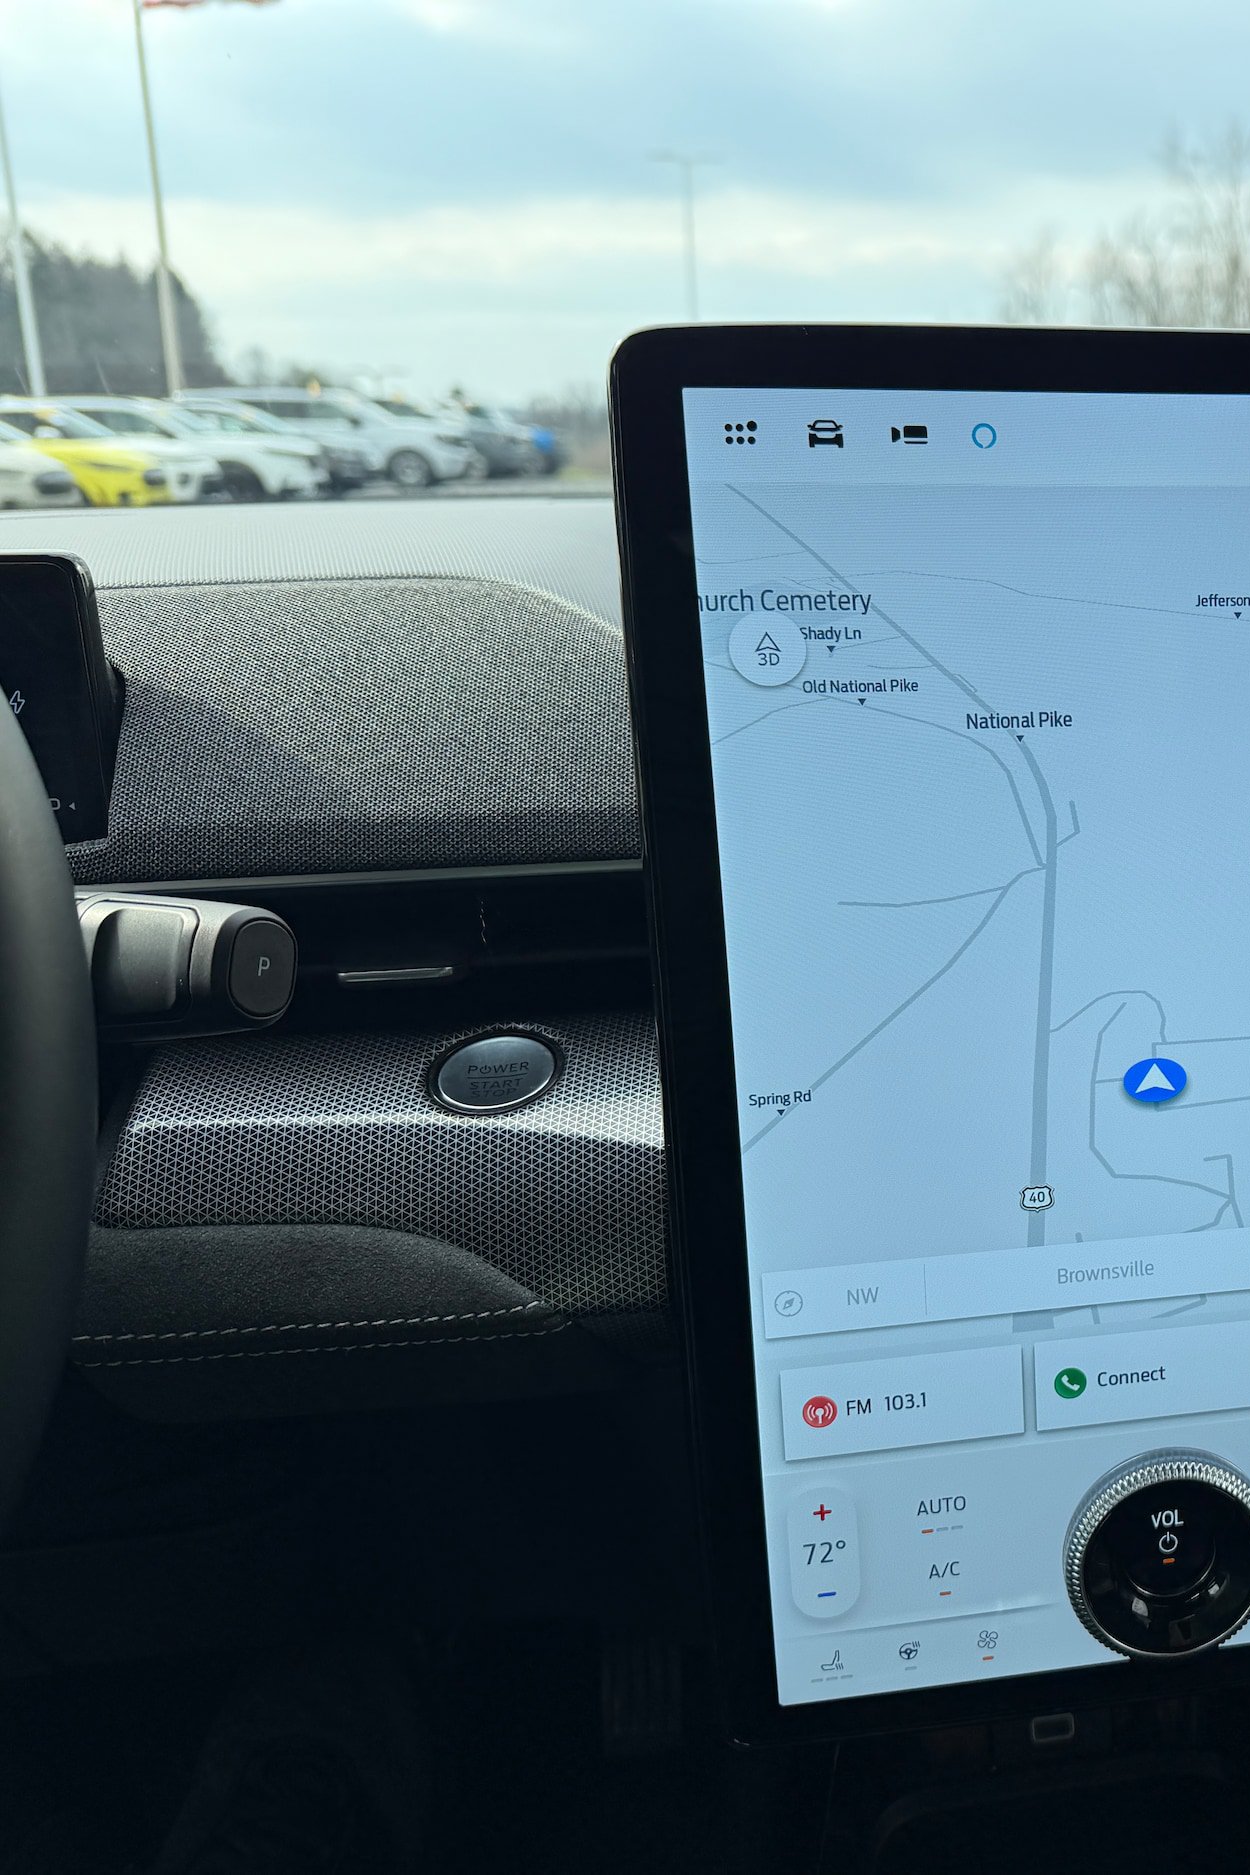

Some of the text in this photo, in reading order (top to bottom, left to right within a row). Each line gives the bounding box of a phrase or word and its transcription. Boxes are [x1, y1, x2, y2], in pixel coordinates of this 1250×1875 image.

[760, 589, 872, 615] Cemetery
[1195, 593, 1250, 607] Jefferson
[800, 626, 862, 643] Shady Ln
[757, 652, 781, 666] 3D
[802, 678, 919, 694] Old National Pike
[966, 710, 1073, 730] National Pike
[257, 956, 271, 977] P
[470, 1078, 523, 1090] START
[472, 1087, 517, 1098] STOP
[748, 1088, 813, 1107] Spring Rd
[1029, 1191, 1046, 1204] 40
[1057, 1259, 1155, 1285] Brownsville
[847, 1286, 880, 1306] NW
[1097, 1365, 1166, 1387] Connect
[846, 1392, 926, 1416] FM 103.1
[917, 1495, 966, 1517] AUTO
[1151, 1509, 1185, 1528] VOL
[802, 1539, 846, 1565] 72°
[928, 1561, 960, 1580] A/C
